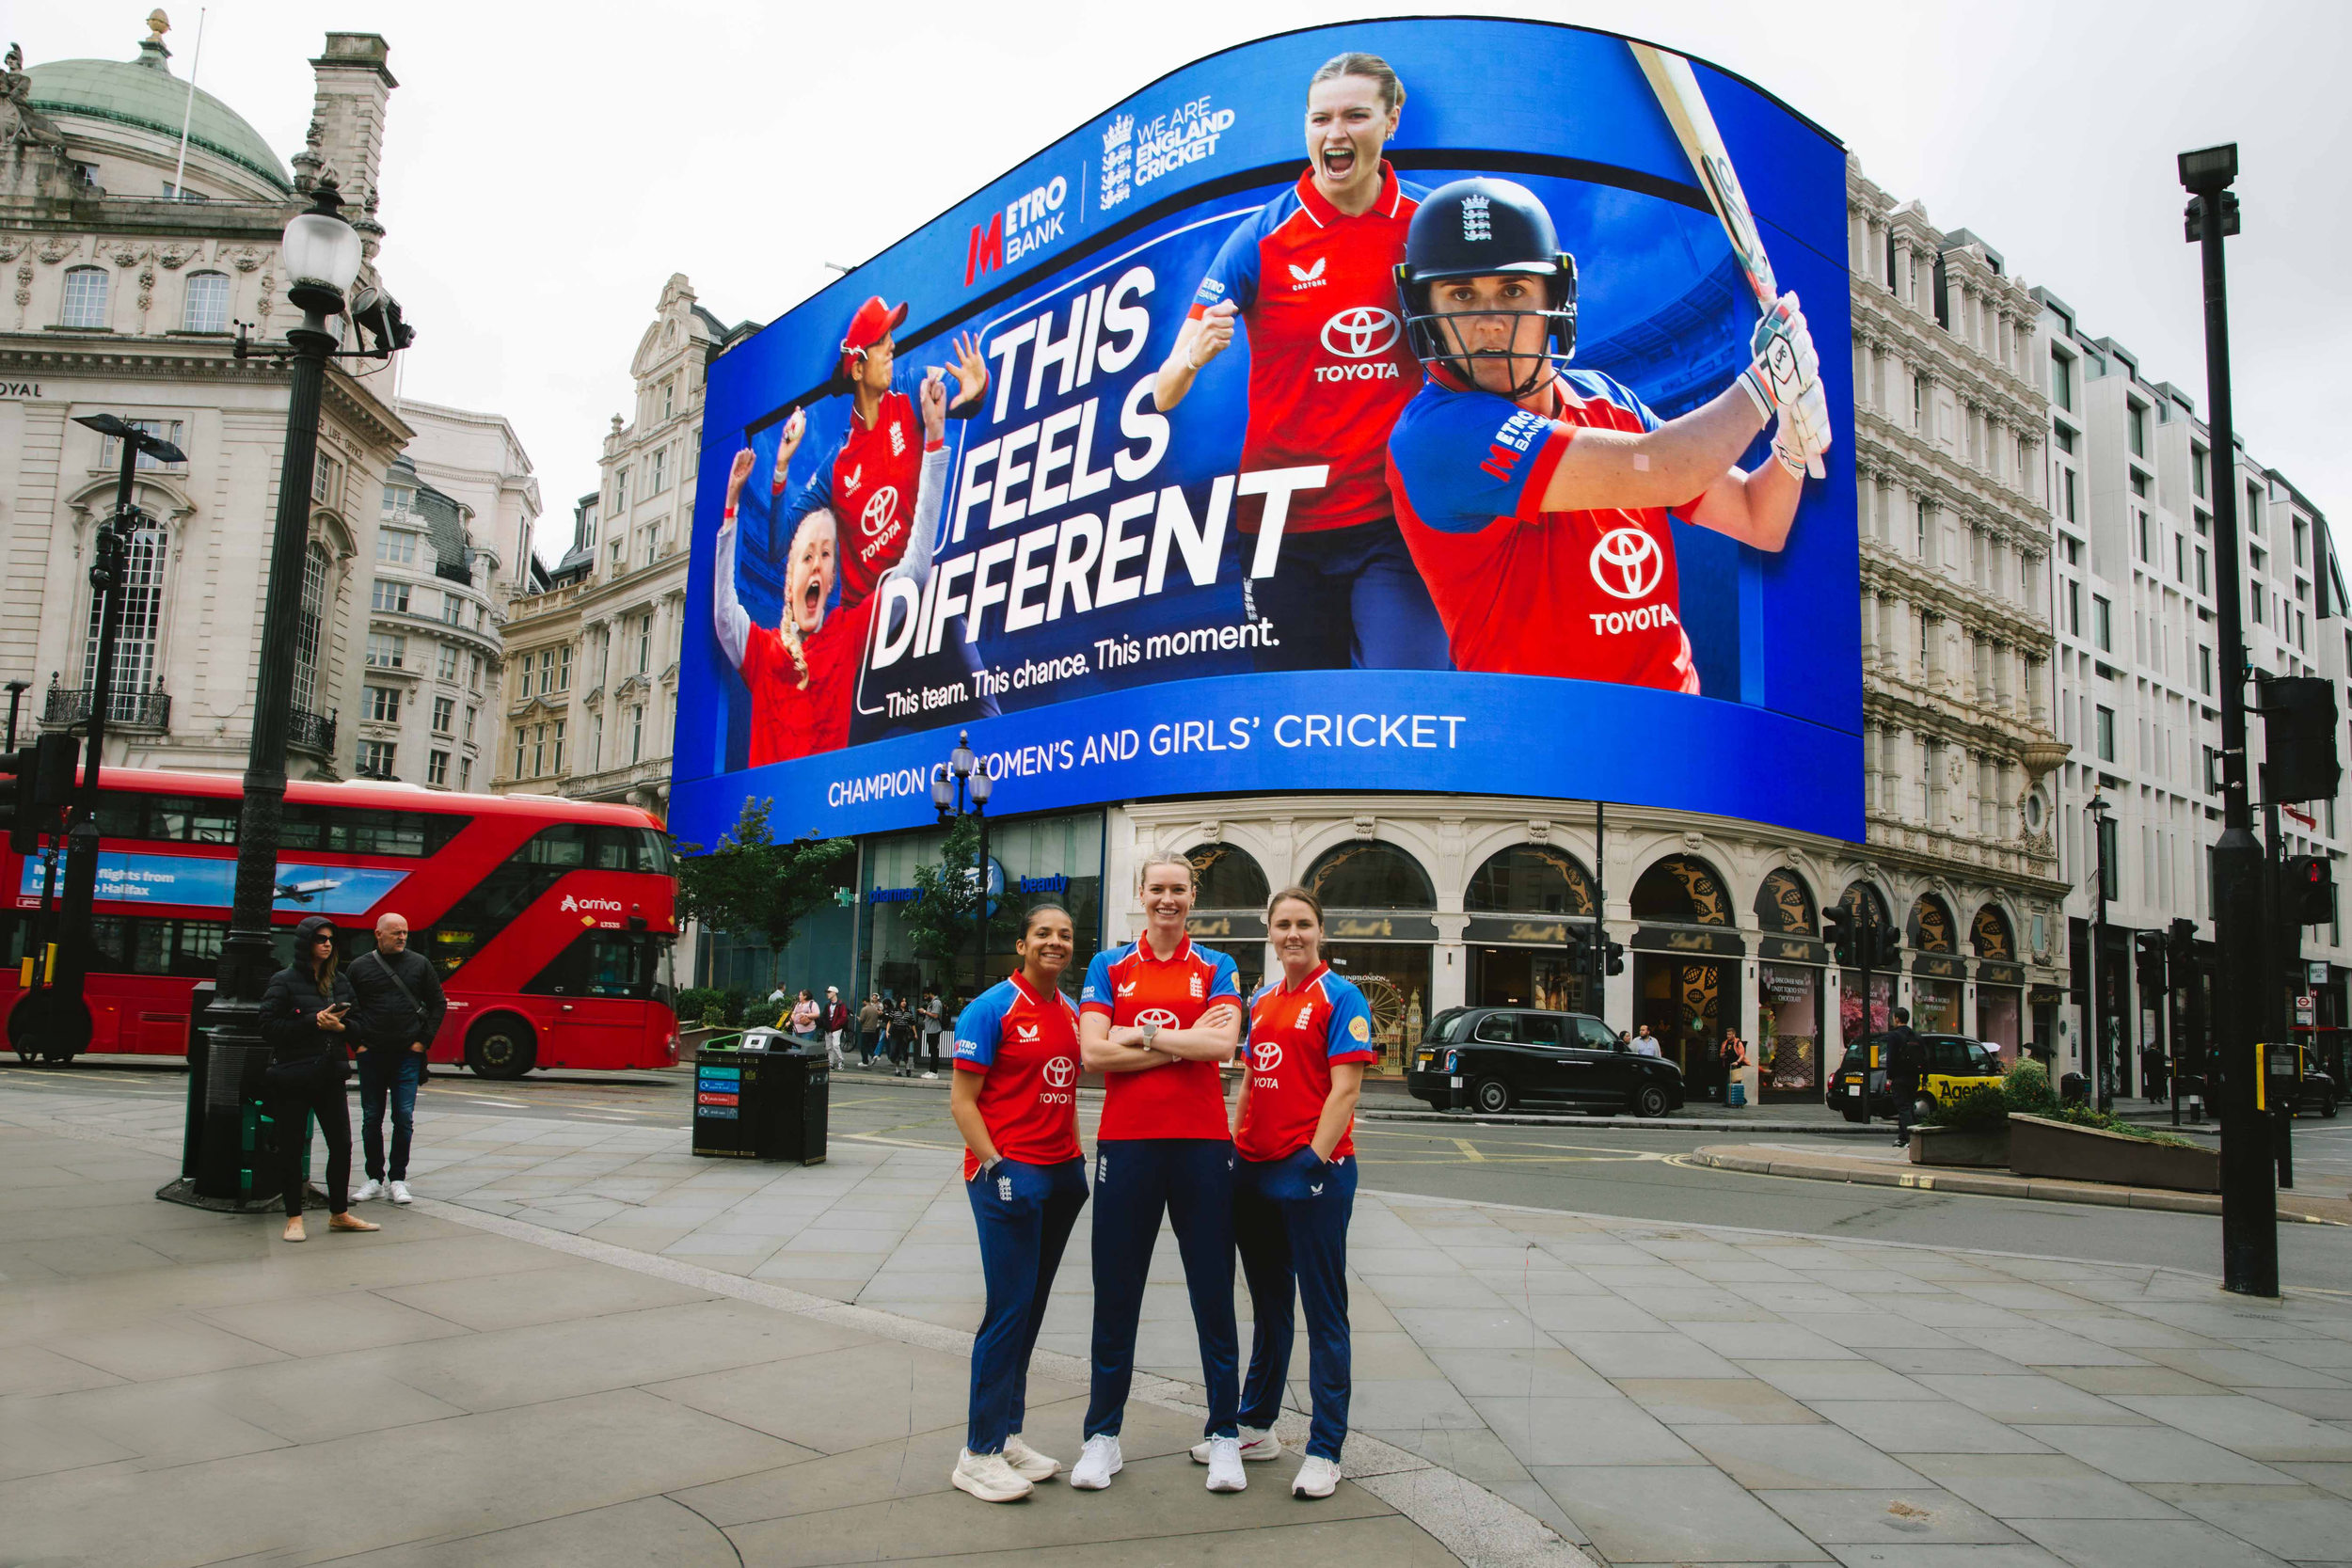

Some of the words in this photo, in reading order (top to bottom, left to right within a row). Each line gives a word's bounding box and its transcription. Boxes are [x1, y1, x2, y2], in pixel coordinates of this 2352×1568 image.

[1135, 108, 1236, 167] ENGLAND
[1136, 114, 1167, 145] WE
[1169, 95, 1213, 131] ARE
[1134, 133, 1221, 187] CRICKET
[964, 175, 1068, 288] METRO
[1005, 211, 1066, 265] BANK
[988, 265, 1156, 425] THIS
[1314, 362, 1400, 382] TOYOTA
[345, 438, 364, 461] OFFICE
[1514, 415, 1550, 451] BANK
[951, 372, 1171, 544] FEELS
[860, 519, 901, 562] TOYOTA
[870, 464, 1330, 671] DIFFERENT
[1589, 603, 1678, 636] TOYOTA
[885, 689, 919, 720] This
[921, 682, 969, 710] team.
[972, 662, 1009, 700] This
[1013, 652, 1089, 689] chance.
[1094, 633, 1141, 671] This
[1146, 616, 1280, 660] moment.
[828, 765, 925, 808] CHAMPION
[1080, 729, 1140, 766] AND
[1273, 712, 1467, 750] CRICKET
[98, 867, 140, 882] flights
[143, 870, 175, 883] from
[102, 882, 150, 896] Halifax
[867, 885, 924, 906] pharmacy
[1020, 872, 1070, 895] beauty
[579, 897, 622, 911] arriva
